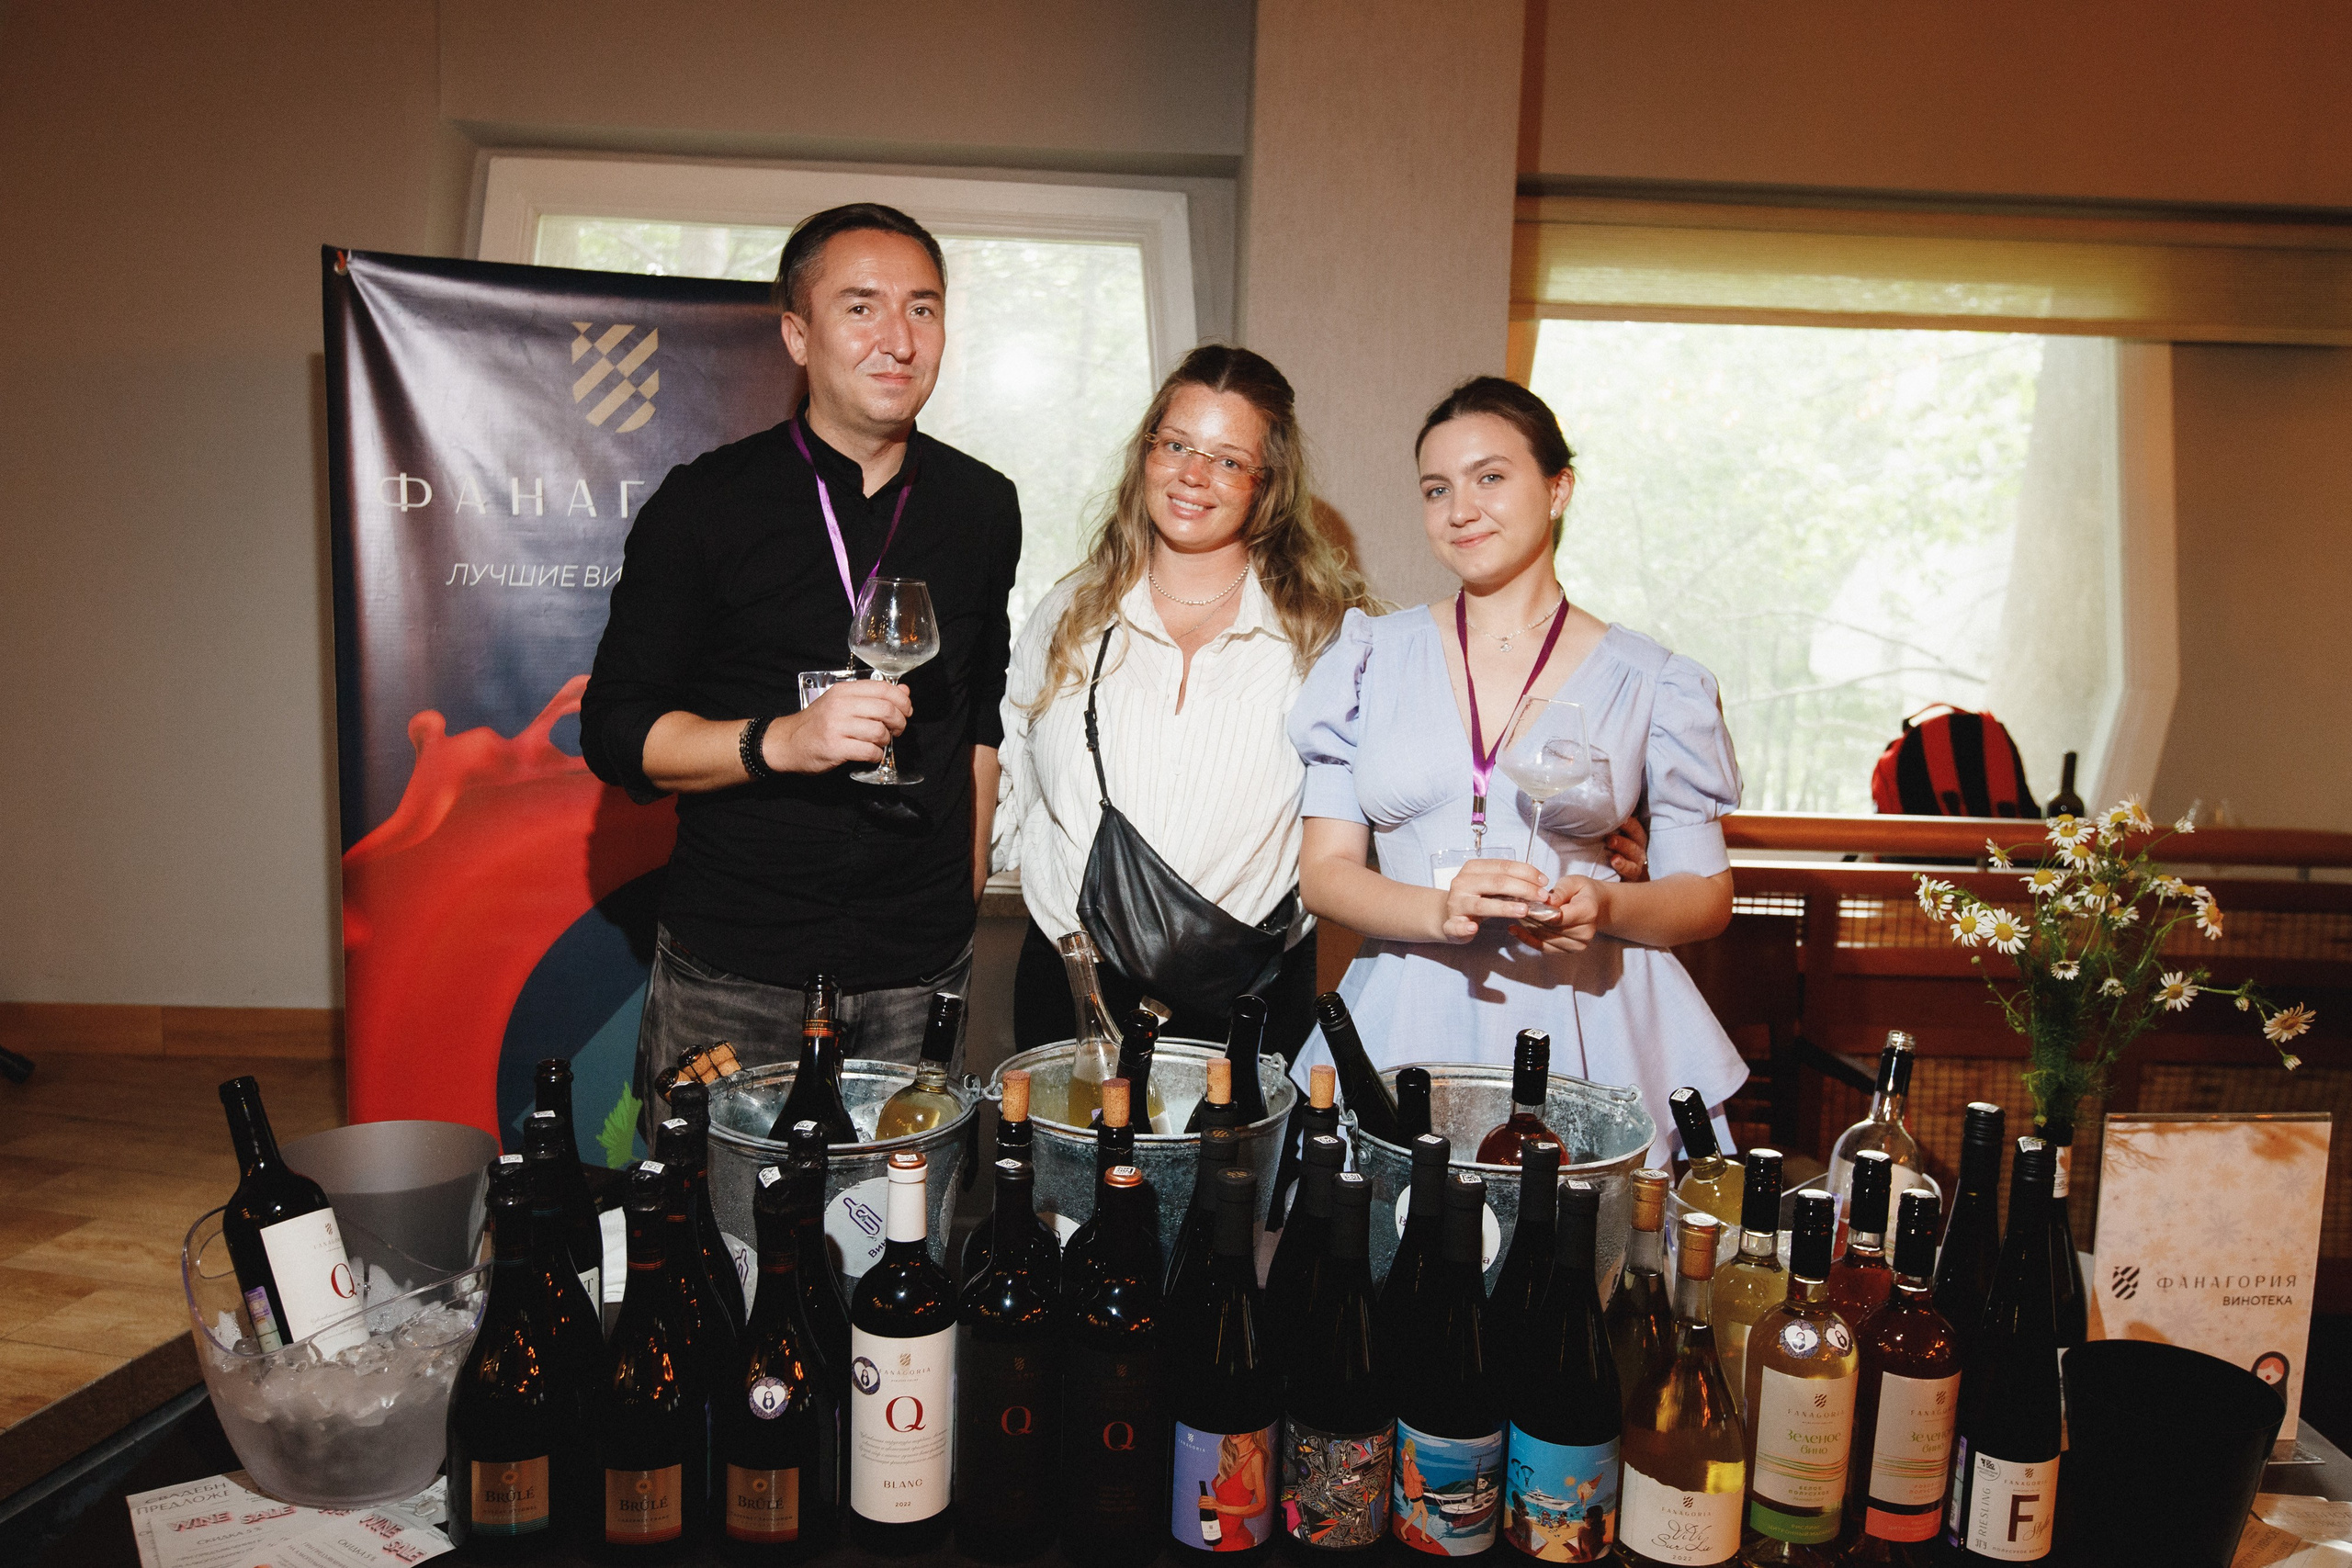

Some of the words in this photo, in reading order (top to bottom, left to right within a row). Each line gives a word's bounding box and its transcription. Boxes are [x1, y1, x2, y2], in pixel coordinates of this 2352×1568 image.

[446, 562, 578, 588] ЛУЧШИЕ
[331, 1263, 357, 1299] Q
[2155, 1274, 2297, 1290] ФАНАГОРИЯ
[2222, 1295, 2293, 1306] ВИНОТЕКА
[886, 1395, 927, 1432] Q
[1001, 1405, 1033, 1436] Q
[1102, 1421, 1136, 1450] Q
[884, 1478, 923, 1489] BLANC
[168, 1511, 233, 1532] WINE
[240, 1505, 297, 1525] SALE
[1978, 1487, 1991, 1537] RIESLING
[2007, 1494, 2040, 1542] F
[196, 1531, 243, 1545] СКИДКА
[359, 1514, 405, 1539] WINE
[382, 1540, 428, 1564] SALE
